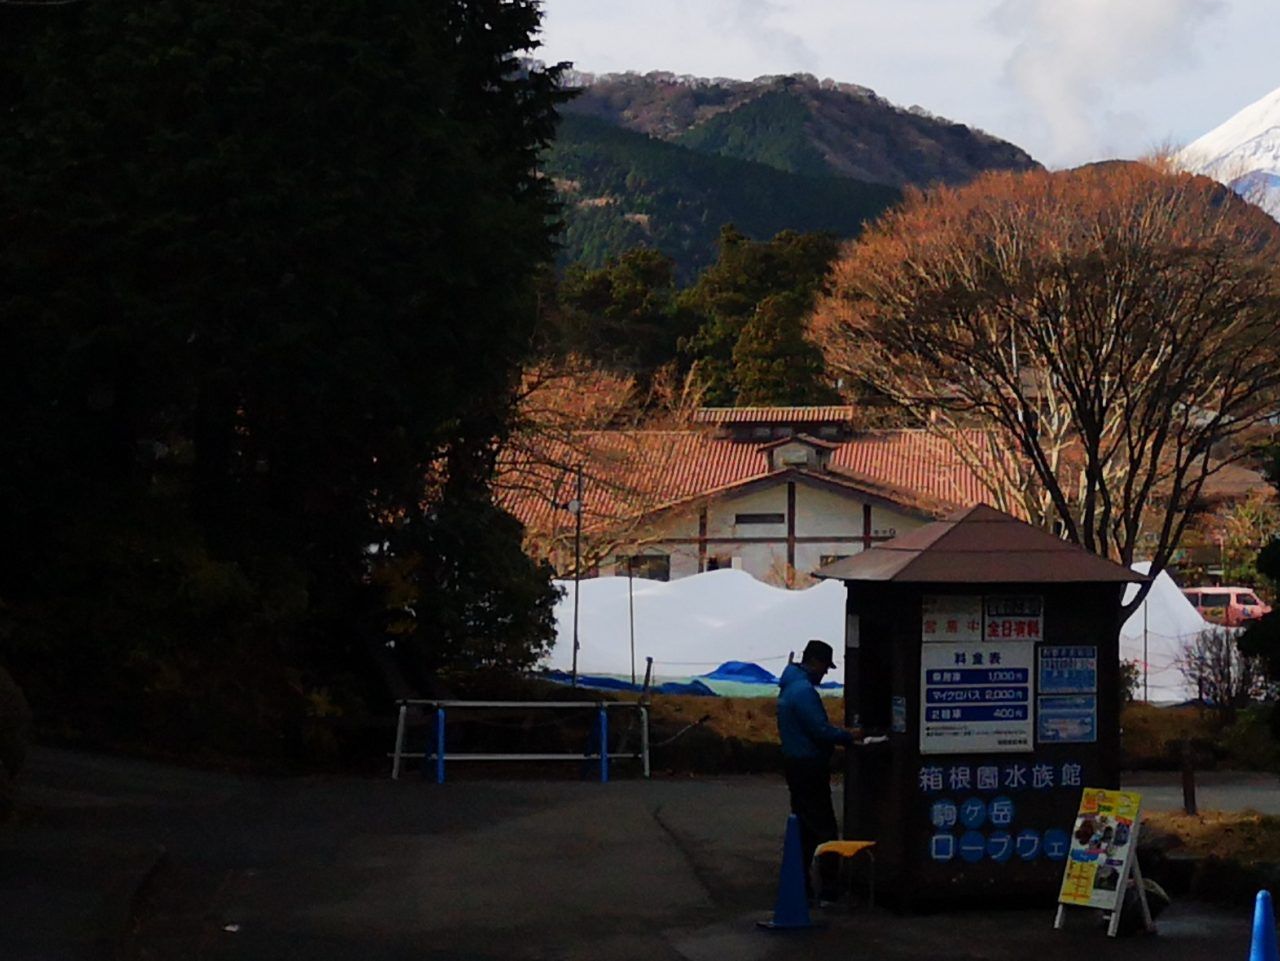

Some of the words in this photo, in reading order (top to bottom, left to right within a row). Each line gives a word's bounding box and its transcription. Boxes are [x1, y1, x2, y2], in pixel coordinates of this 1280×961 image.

[932, 690, 981, 700] マイクロバス
[919, 762, 1082, 792] 箱根園水族館
[932, 834, 1065, 860] ロープウェ
